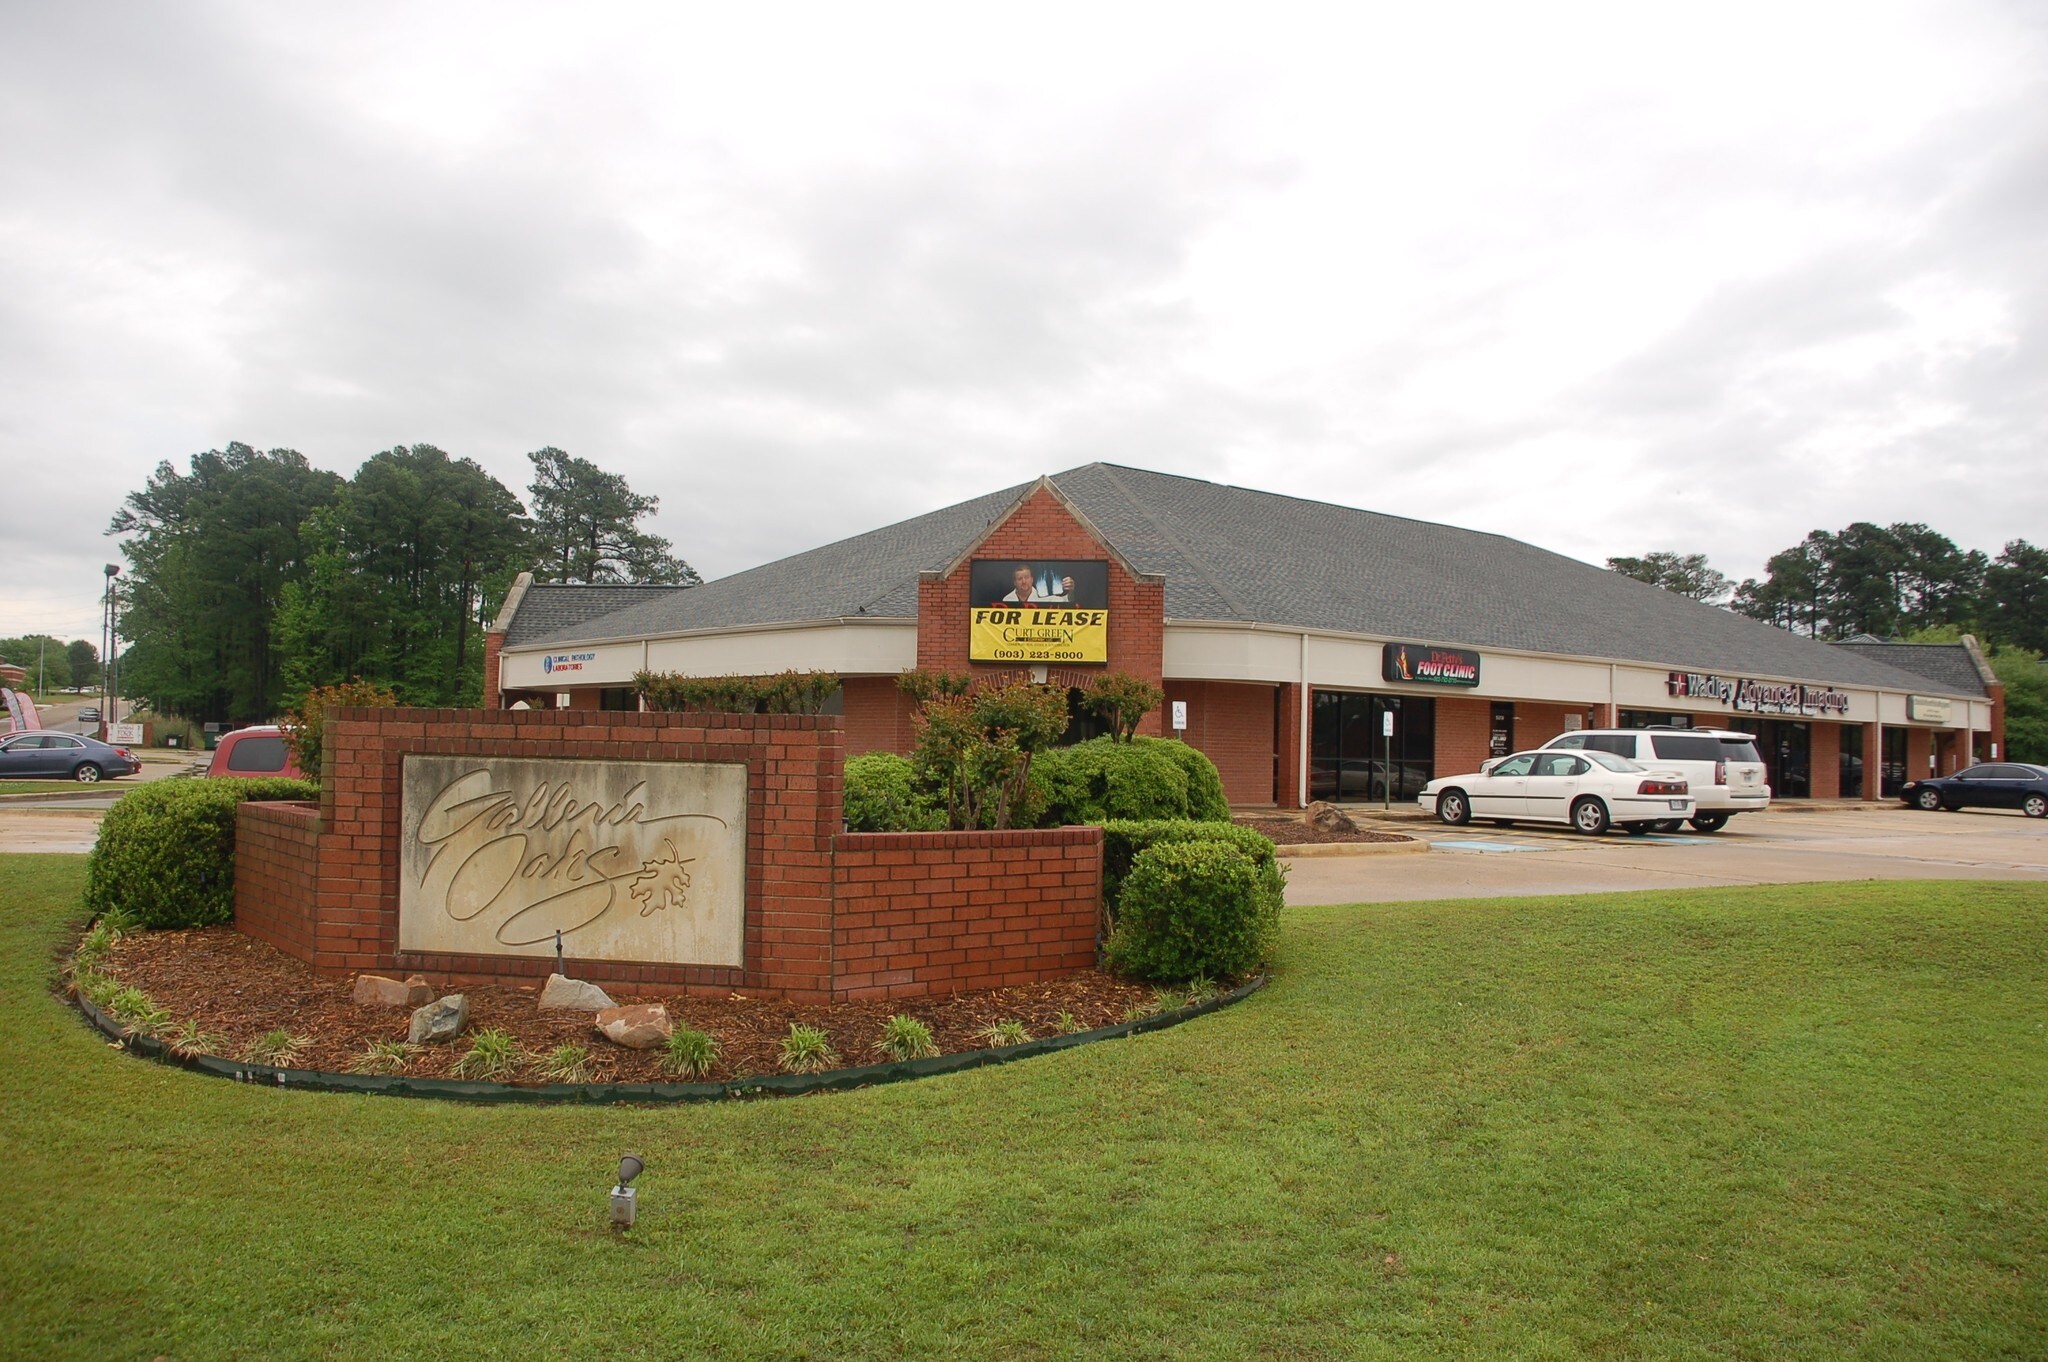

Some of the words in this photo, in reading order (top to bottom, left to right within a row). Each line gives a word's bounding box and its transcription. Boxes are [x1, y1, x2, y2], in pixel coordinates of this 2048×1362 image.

[976, 611, 1022, 625] FOR
[1032, 612, 1105, 626] LEASE
[1003, 627, 1034, 643] CURT
[1037, 628, 1074, 643] GREEN
[993, 649, 1025, 659] (903)
[1029, 651, 1084, 660] 223-8000
[1417, 661, 1443, 676] FOOT
[1443, 664, 1476, 680] CLINIC
[1687, 673, 1734, 704] Wadley
[1738, 679, 1801, 706] Advanced
[1801, 686, 1849, 713] Imaging
[416, 768, 728, 889] Galleria
[445, 829, 645, 946] Oaks
